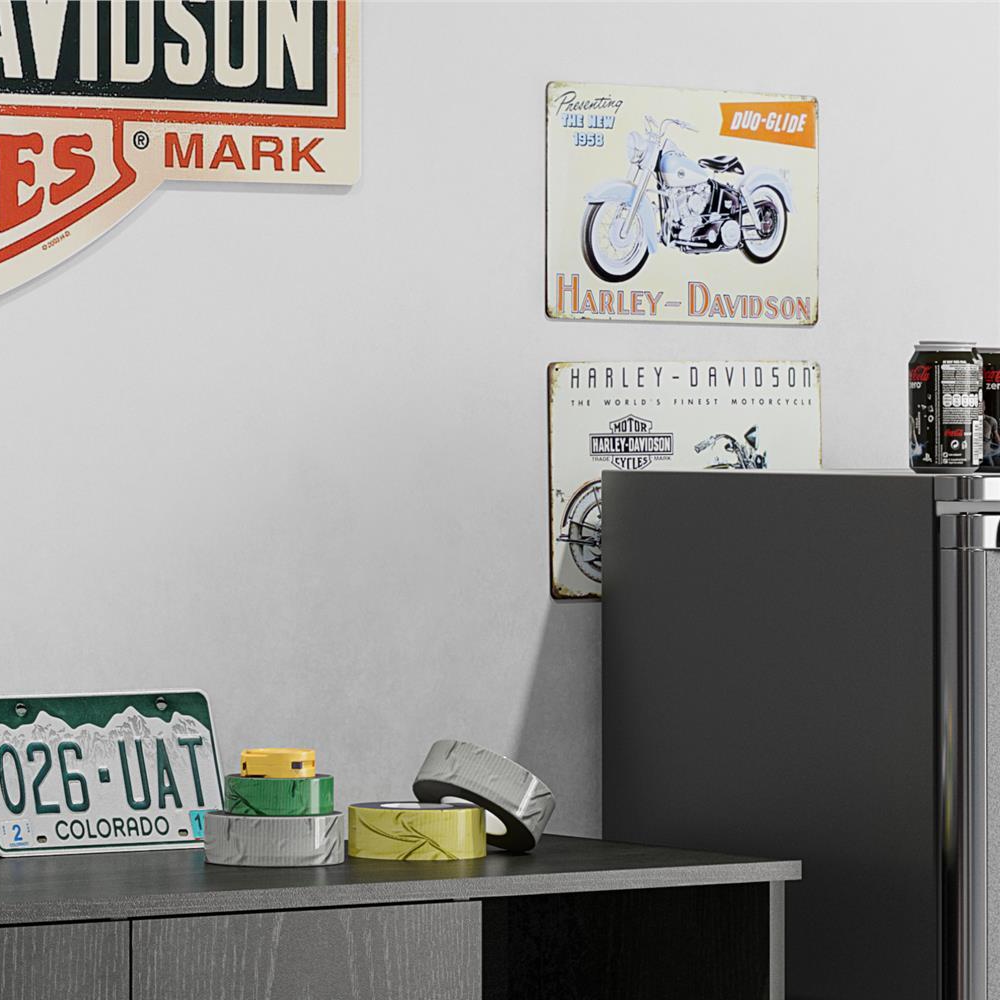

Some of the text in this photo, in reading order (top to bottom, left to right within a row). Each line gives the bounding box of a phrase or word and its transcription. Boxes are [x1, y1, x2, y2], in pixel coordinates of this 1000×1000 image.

[554, 91, 623, 116] Presenting
[562, 113, 616, 129] THE NEW
[730, 110, 807, 133] DUO-GLIDE
[573, 132, 605, 147] 1958
[163, 132, 325, 173] MARK
[556, 273, 811, 320] HARLEY-DAVIDSON
[571, 397, 812, 406] THE WORLD'S FINEST MOTORCYCLE
[613, 417, 647, 433] MOTOR
[614, 456, 648, 470] CYCLES
[55, 815, 170, 840] COLORADO
